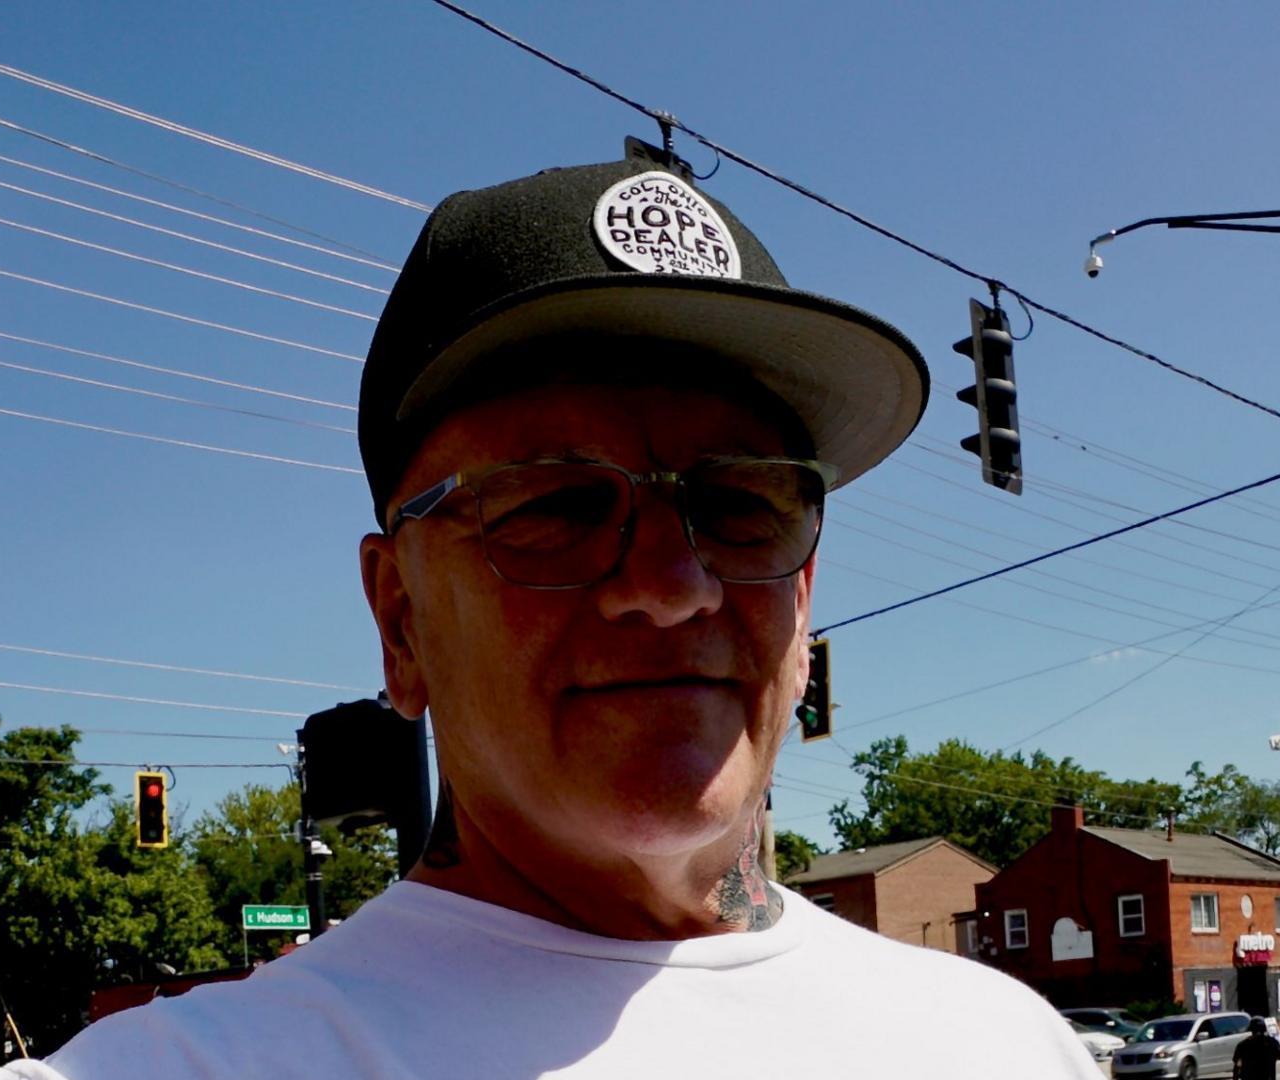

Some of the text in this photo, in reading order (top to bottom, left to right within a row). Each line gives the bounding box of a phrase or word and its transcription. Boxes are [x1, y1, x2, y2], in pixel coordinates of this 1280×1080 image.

[654, 189, 682, 209] The
[668, 184, 708, 218] OHIO
[607, 205, 723, 245] HOPE
[610, 229, 730, 273] DEALER
[622, 243, 726, 277] COMMUNITY
[257, 911, 294, 923] Hudson
[1239, 931, 1275, 951] metro
